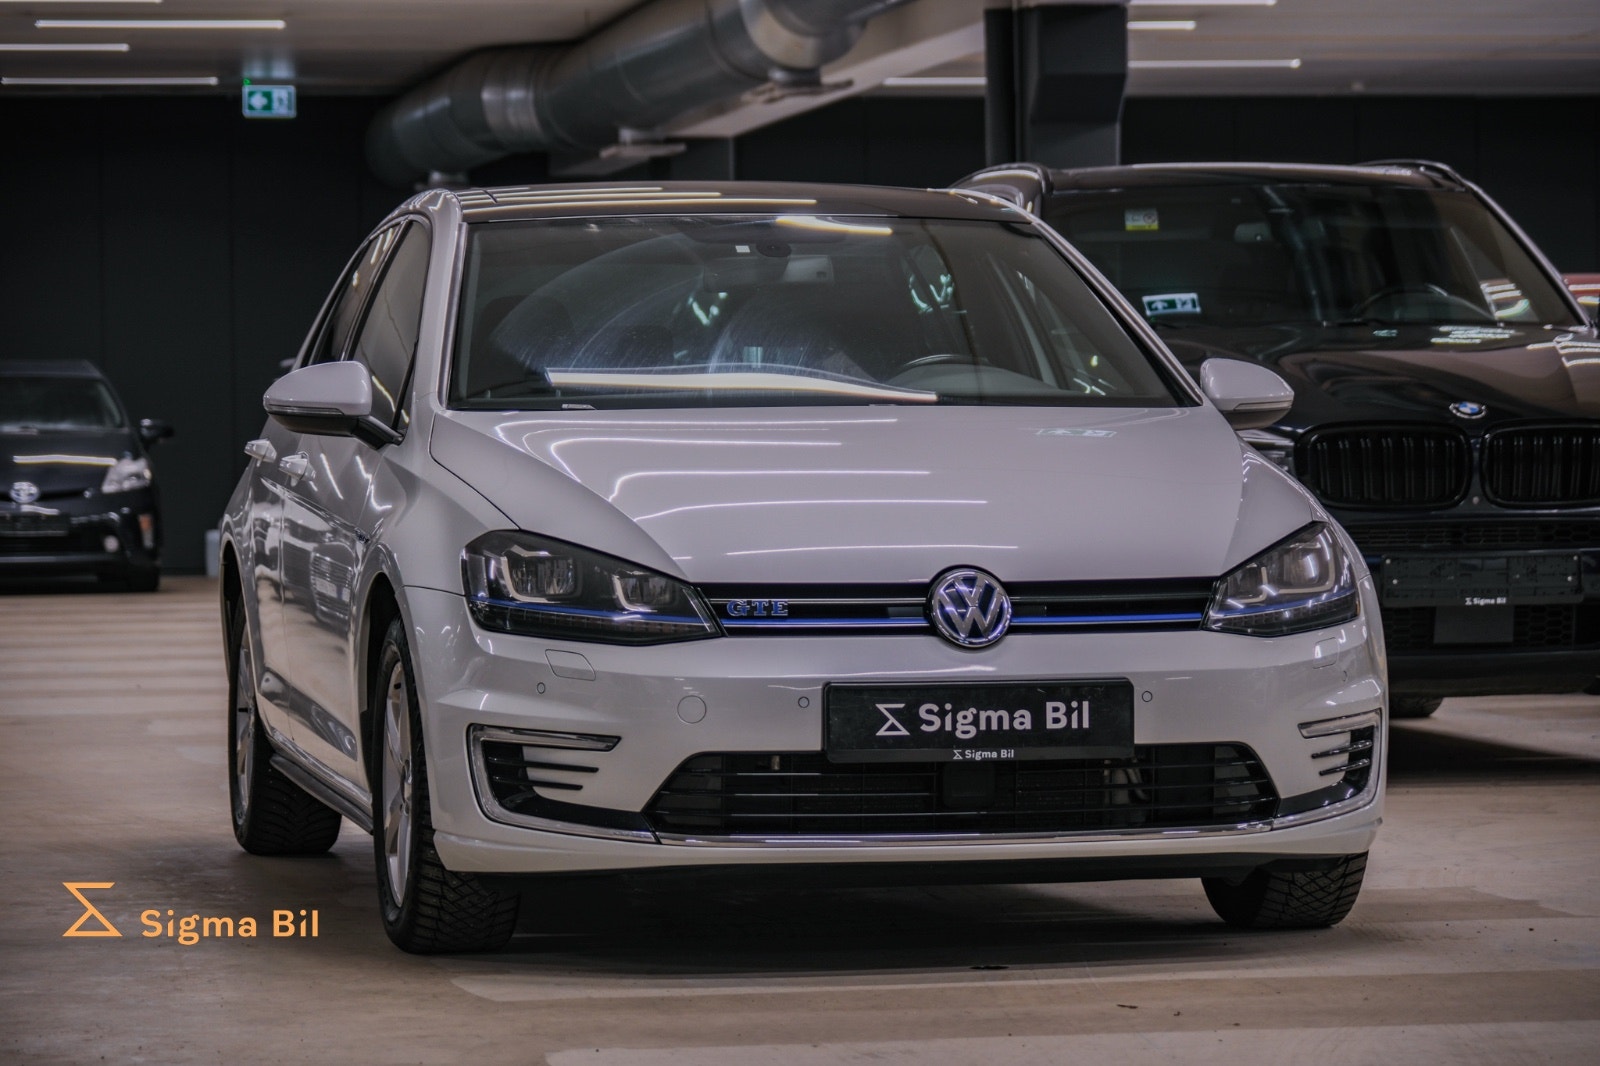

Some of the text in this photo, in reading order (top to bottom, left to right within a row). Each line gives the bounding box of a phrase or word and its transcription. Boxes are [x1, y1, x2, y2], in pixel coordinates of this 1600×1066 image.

[726, 599, 788, 617] GTE
[1473, 597, 1495, 606] Sigma
[918, 701, 1090, 739] Sigma Bil
[964, 749, 1015, 761] Sigma Bil
